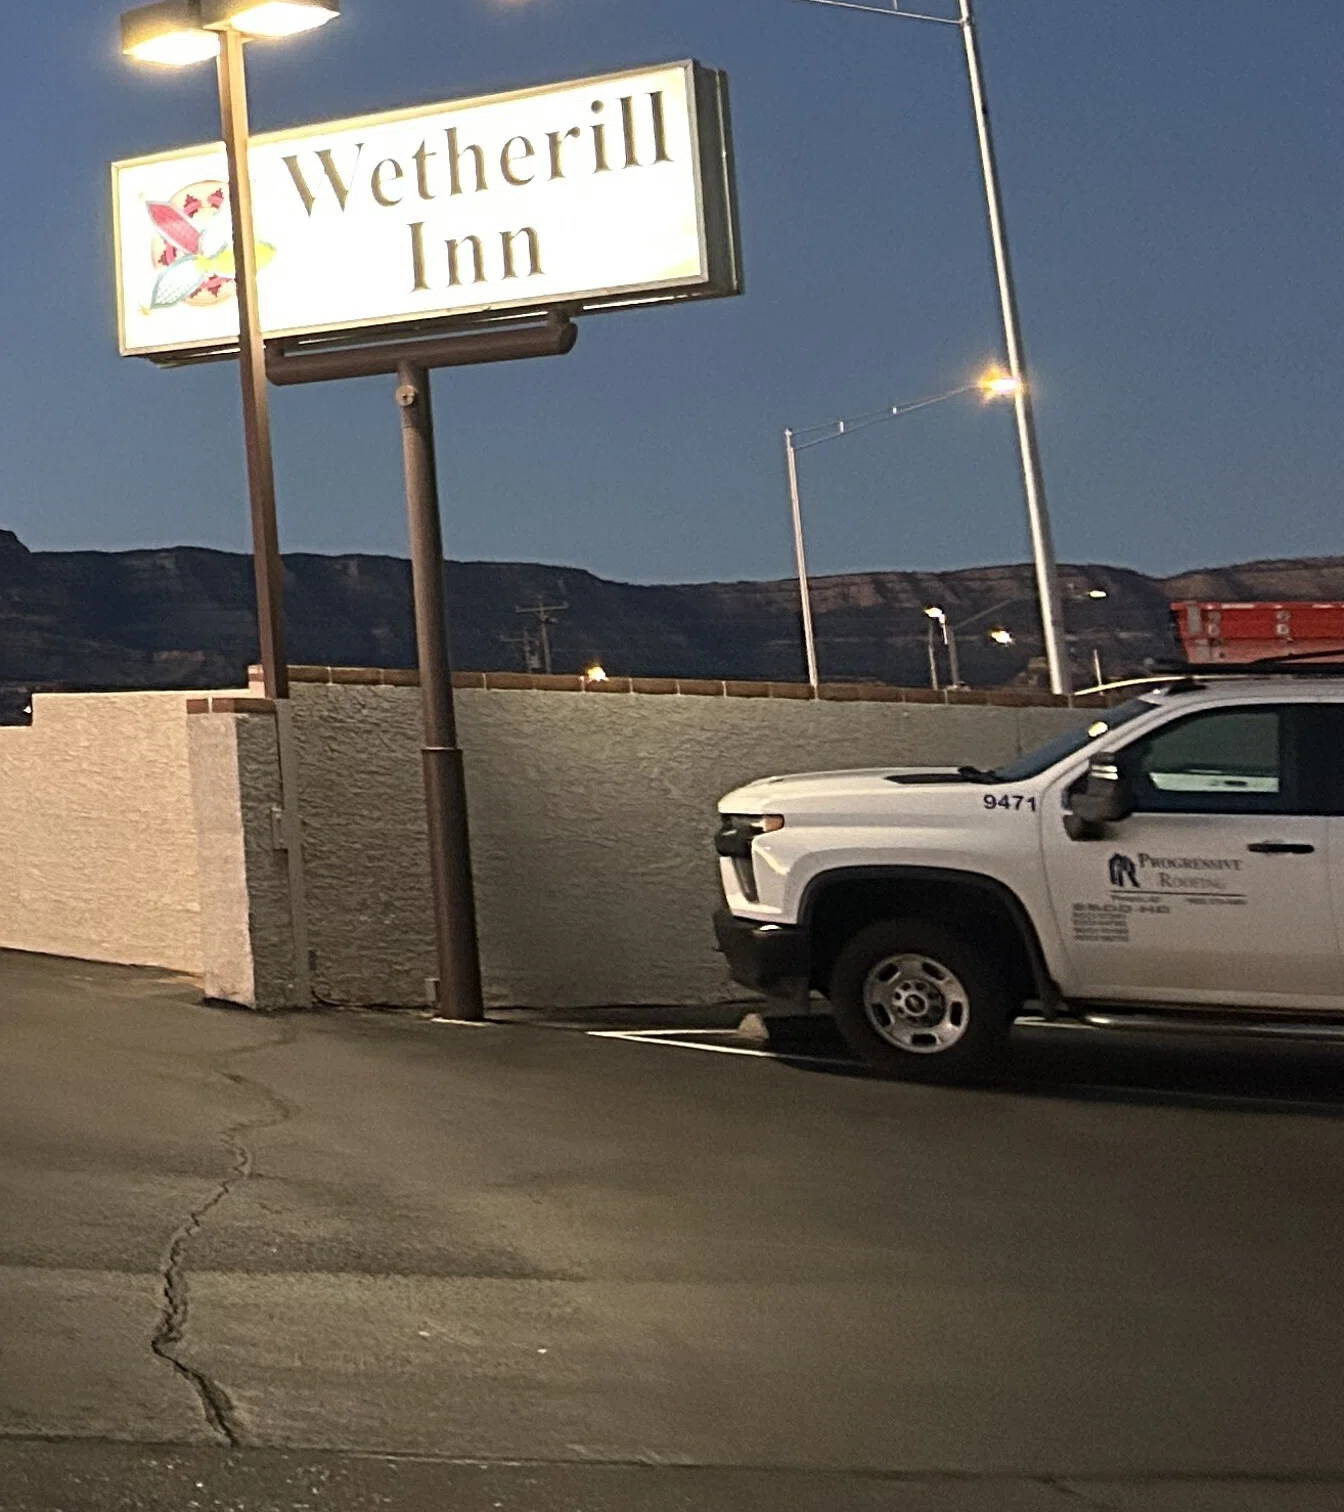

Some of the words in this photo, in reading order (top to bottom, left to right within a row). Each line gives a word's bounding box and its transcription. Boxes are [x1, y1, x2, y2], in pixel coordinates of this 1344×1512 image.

[280, 90, 675, 219] Wetherill
[408, 220, 547, 293] Inn
[983, 793, 1037, 812] 9471
